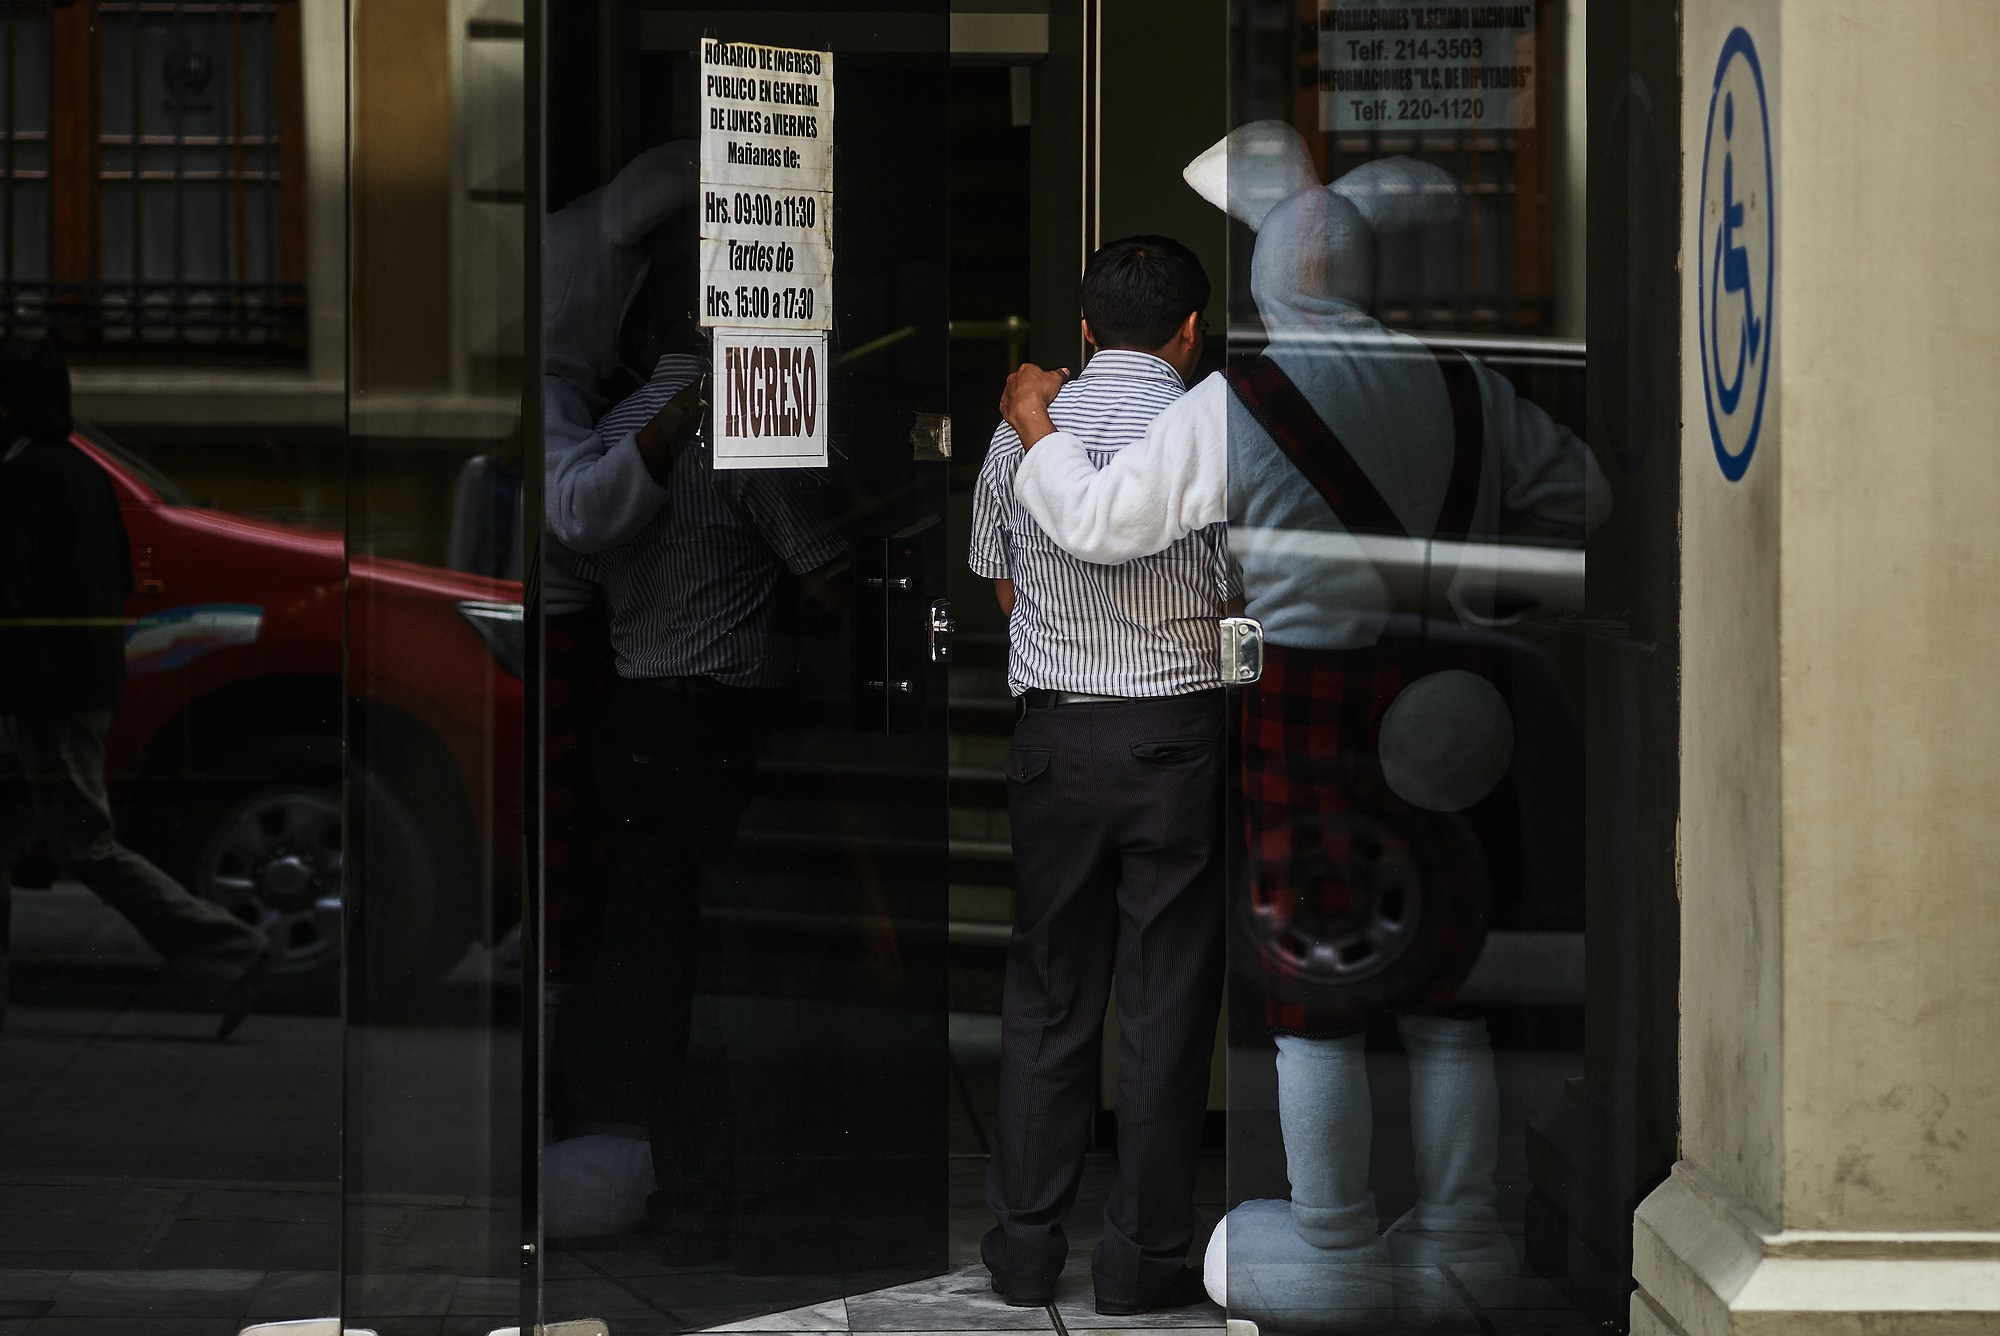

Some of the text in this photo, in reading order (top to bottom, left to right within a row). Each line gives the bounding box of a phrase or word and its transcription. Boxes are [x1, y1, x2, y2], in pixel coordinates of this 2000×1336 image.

[1320, 8, 1409, 32] INFORMACIONES
[1471, 6, 1531, 29] NACIONAL"
[705, 42, 821, 76] HORARIO DE INGRESO
[1348, 38, 1483, 61] Telf. 214-3503
[707, 75, 819, 107] PUBLICO EN GENERAL
[1319, 68, 1413, 92] INFORMACIONES
[1445, 67, 1460, 89] DE
[1462, 65, 1531, 89] DIPUTADOS"
[710, 108, 818, 138] DE LUNES a VIERNES
[1351, 98, 1484, 121] Telf. 220-1120
[728, 141, 801, 169] Mañanas de:
[705, 191, 816, 229] Hrs. 09:00 a 11:30
[728, 239, 794, 273] Tardes de
[707, 285, 814, 320] Hrs. 15:00 a 17:30
[725, 345, 817, 438] INGRESO
